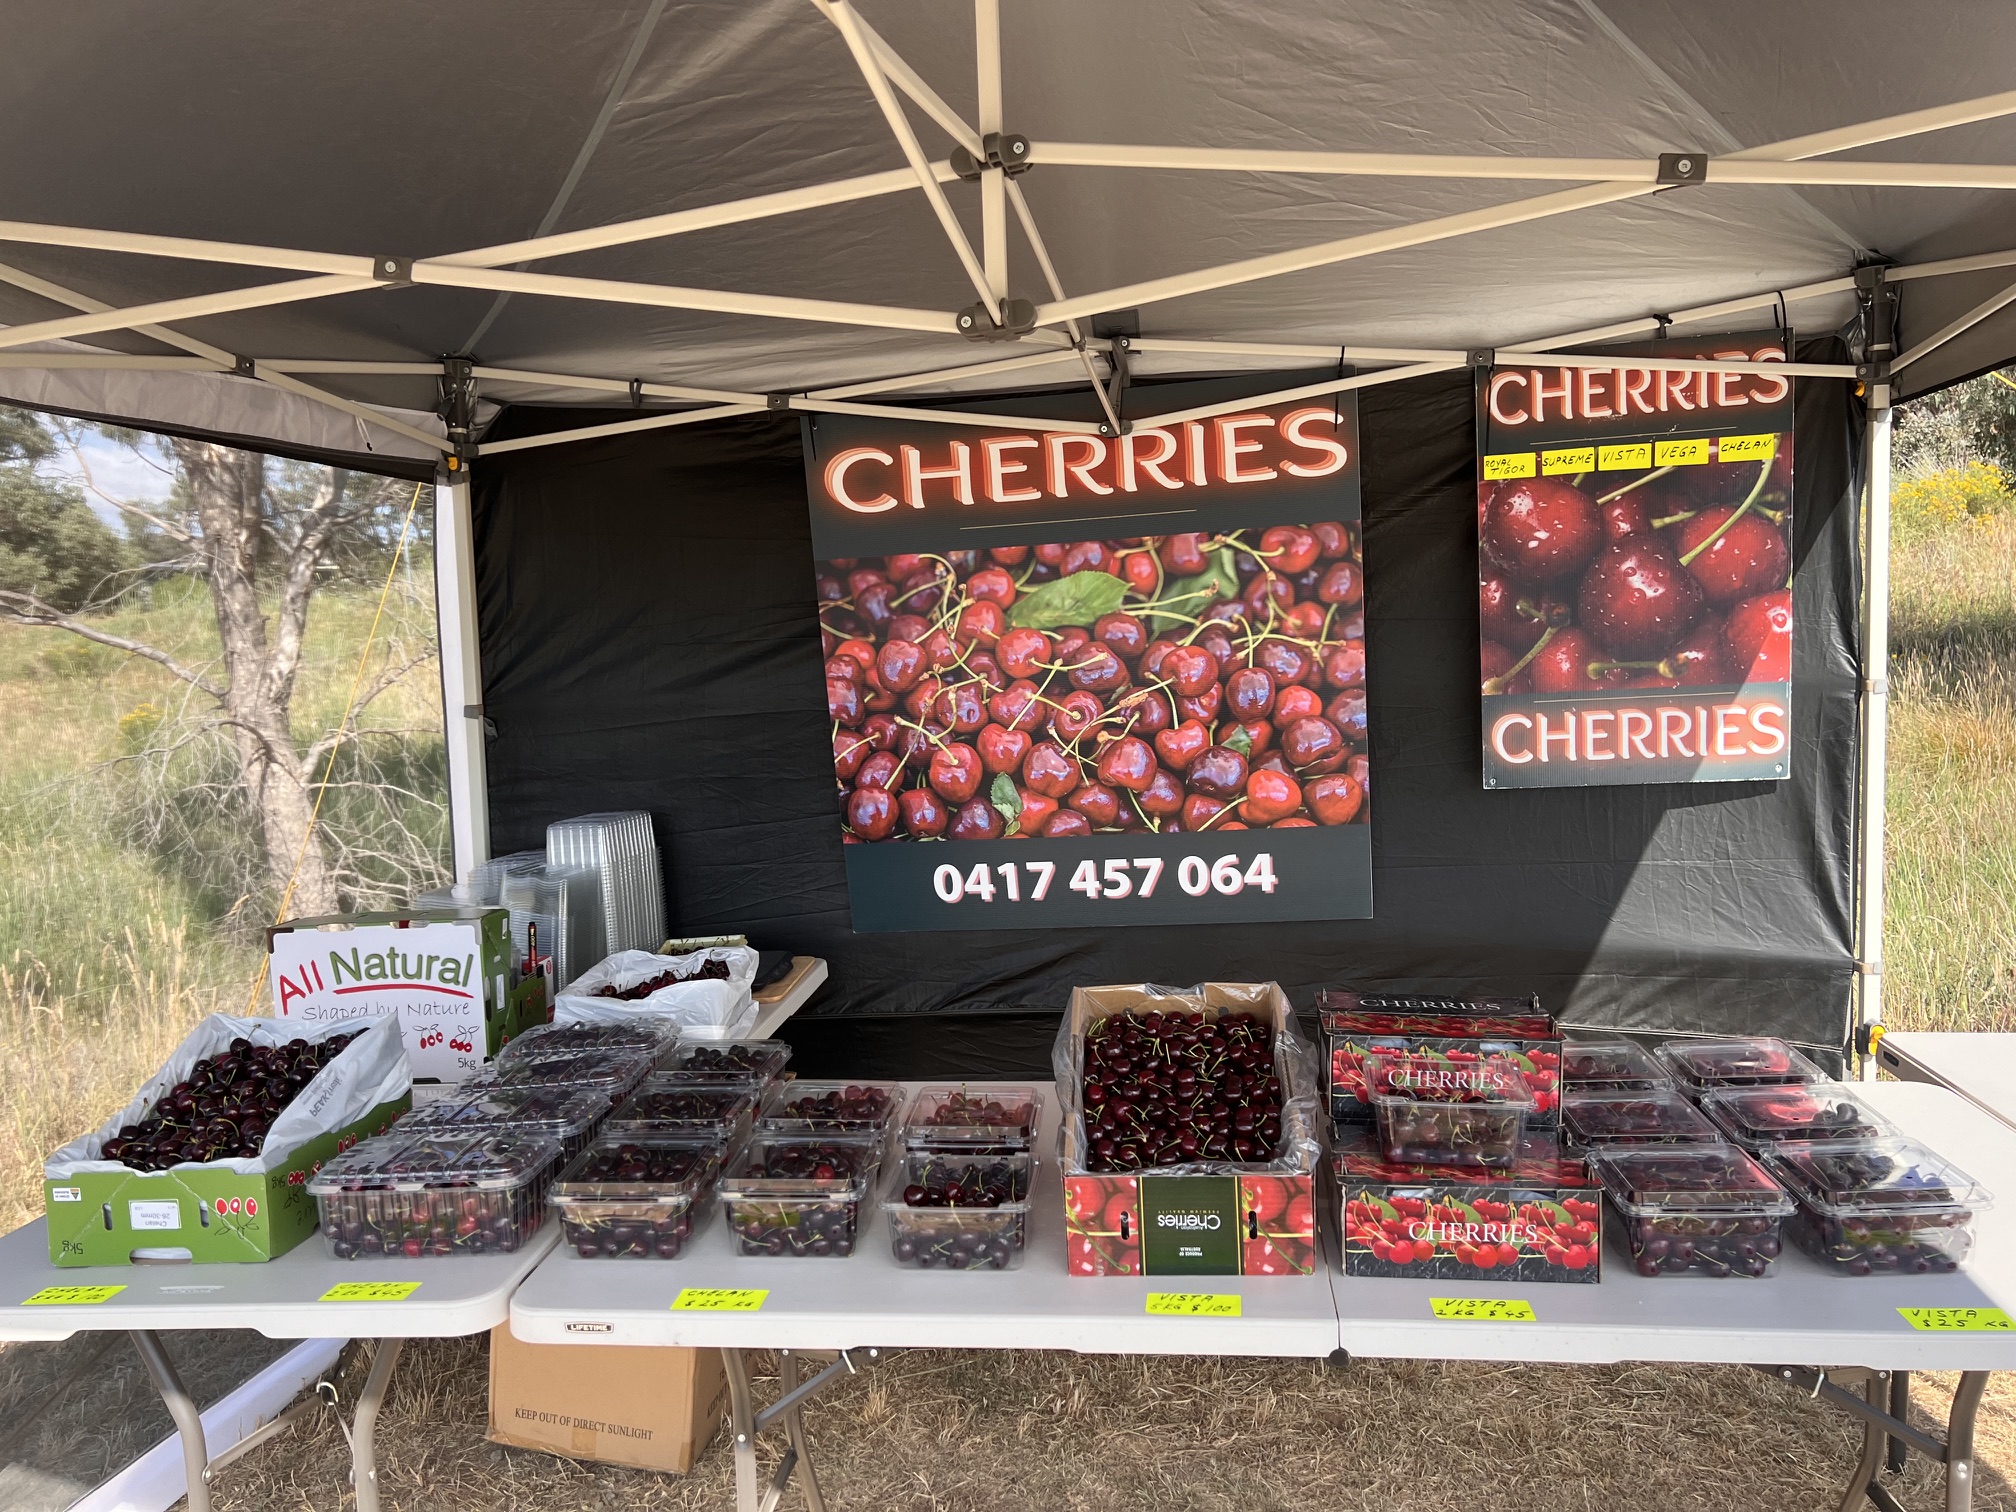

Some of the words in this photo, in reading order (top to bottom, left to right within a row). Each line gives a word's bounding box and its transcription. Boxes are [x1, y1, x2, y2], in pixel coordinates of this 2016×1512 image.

[1485, 347, 1789, 425] CHERRIES
[1661, 446, 1697, 459] VEGA
[1721, 439, 1771, 452] CHELAN
[824, 407, 1348, 514] CHERRIES
[1542, 453, 1594, 467] SUPREME
[1603, 448, 1646, 463] VISTA
[1485, 459, 1511, 468] ROYAL
[1491, 464, 1525, 475] TIGOR
[1491, 703, 1786, 765] CHERRIES
[933, 861, 1055, 903] 0417
[1068, 857, 1164, 898] 457
[1176, 852, 1278, 897] 064
[279, 960, 324, 1016] All
[329, 947, 474, 987] Natural
[302, 1002, 368, 1020] Shaped
[407, 1002, 470, 1017] Nature
[1360, 999, 1501, 1012] CHERRIES
[458, 1057, 476, 1070] 5kg
[1388, 1069, 1504, 1090] CHERRIES
[271, 1175, 286, 1189] 5kg
[1157, 1214, 1221, 1230] Cherries
[1408, 1221, 1538, 1243] CHERRIES
[62, 1240, 84, 1255] 5kg
[1161, 1293, 1213, 1302] VISTA
[1446, 1299, 1506, 1308] VISTA
[1912, 1308, 1978, 1318] VISTA
[570, 1323, 608, 1332] LIFETIME
[515, 1407, 538, 1421] KEEP
[539, 1412, 558, 1424] OUT
[559, 1415, 572, 1426] OF
[572, 1418, 606, 1432] DIRECT
[607, 1424, 653, 1440] SUNLIGHT
